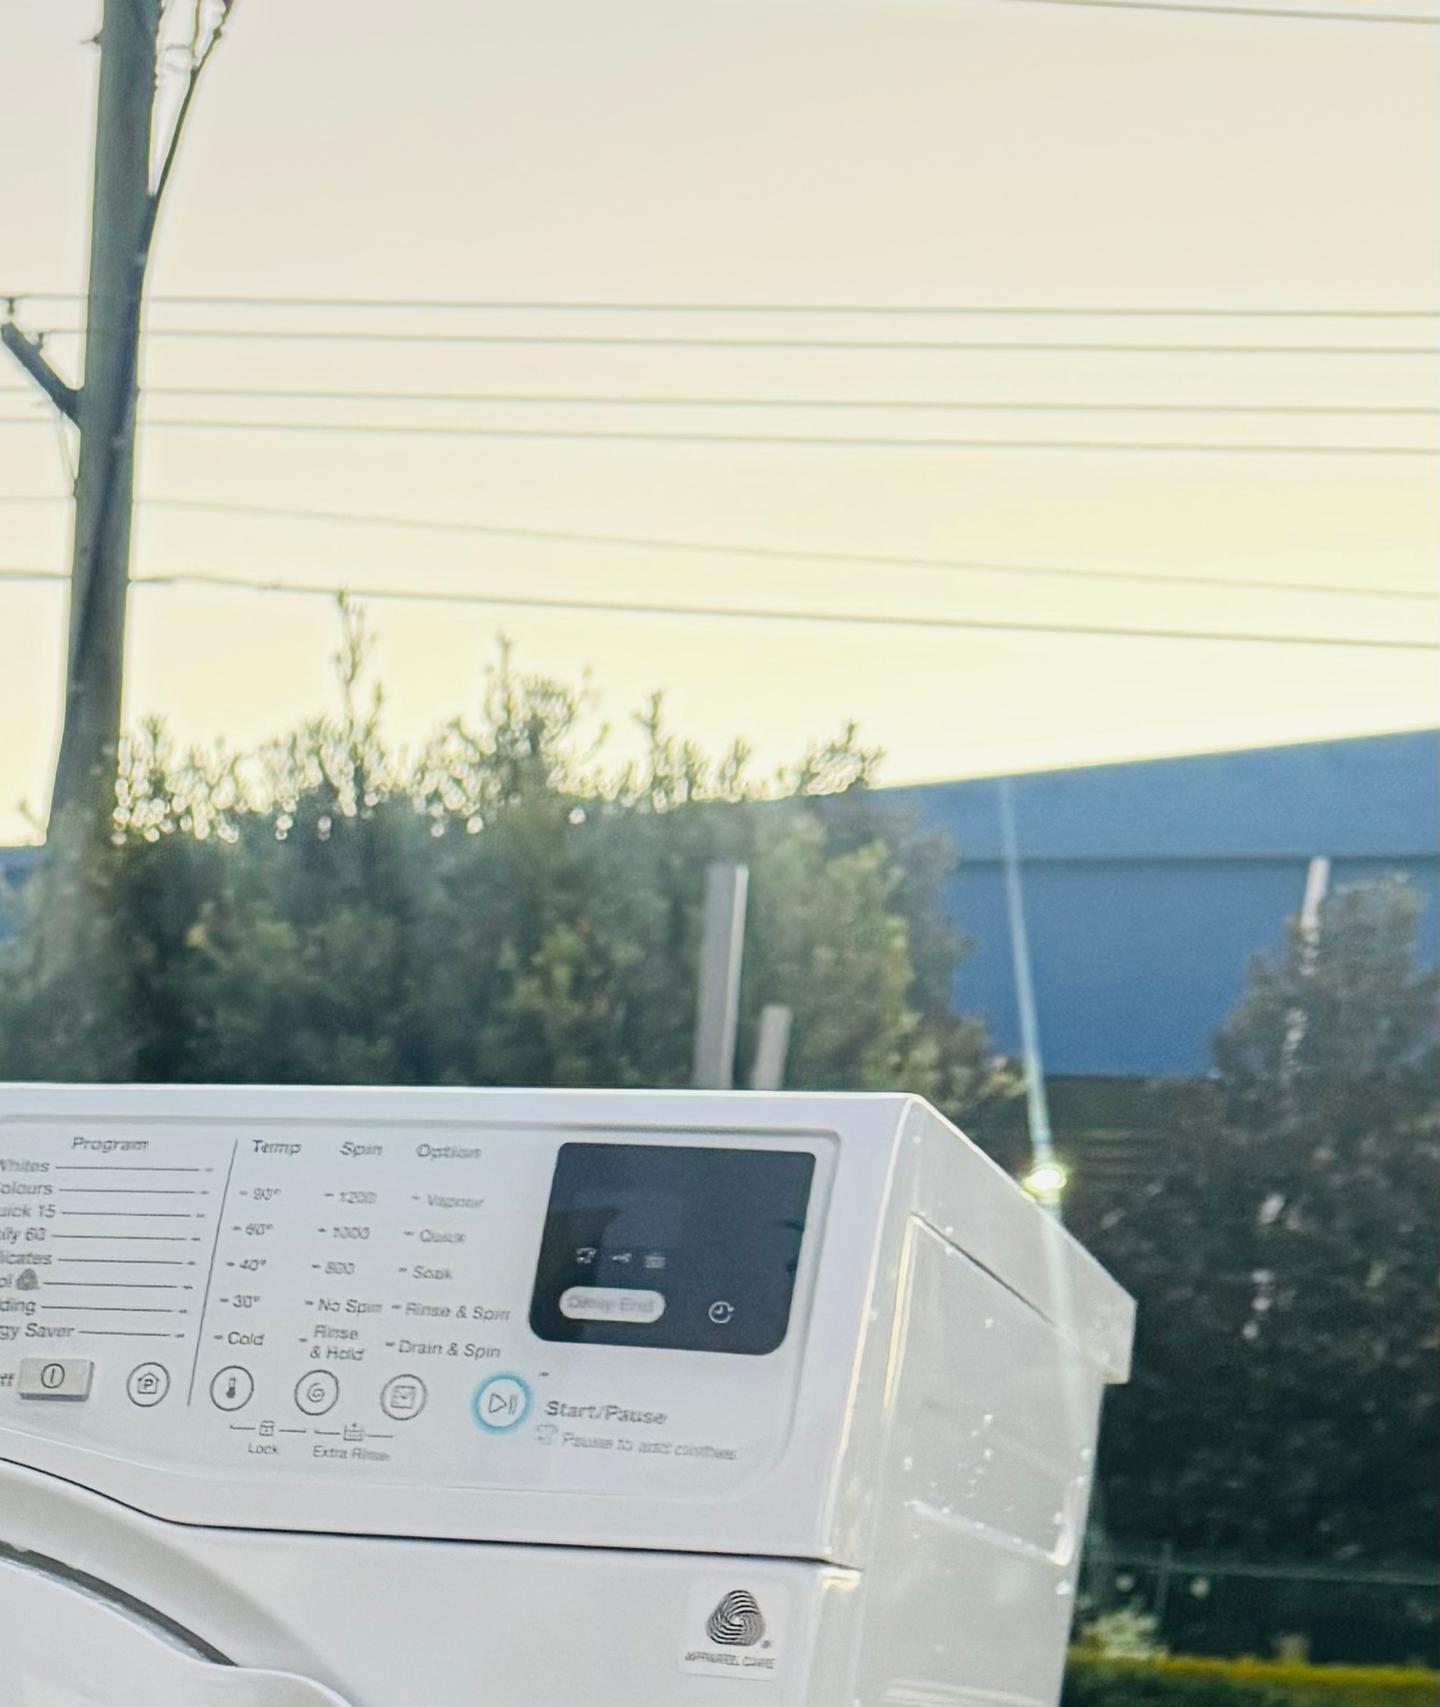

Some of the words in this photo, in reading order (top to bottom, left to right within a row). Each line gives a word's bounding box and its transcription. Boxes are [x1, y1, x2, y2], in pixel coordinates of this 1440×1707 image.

[71, 1136, 149, 1153] Program
[253, 1139, 301, 1155] Temp
[340, 1142, 383, 1157] Spin
[416, 1144, 481, 1161] Option
[38, 1204, 56, 1218] 15
[25, 1227, 46, 1241] 60
[317, 1299, 340, 1312] No
[344, 1300, 383, 1315] Spin
[406, 1303, 450, 1318] Rinse
[455, 1305, 467, 1319] &
[473, 1305, 510, 1322] Spin
[25, 1323, 75, 1338] Saver
[313, 1325, 359, 1341] Rinse
[228, 1332, 265, 1346] Cold
[310, 1347, 321, 1359] &
[326, 1347, 364, 1361] Hold
[399, 1340, 442, 1354] Drain
[447, 1343, 458, 1356] &
[463, 1344, 501, 1360] Spin
[545, 1400, 668, 1425] Start/Pause
[562, 1432, 613, 1450] Pause
[248, 1443, 279, 1456] Lock
[313, 1446, 348, 1459] Extra
[352, 1448, 391, 1461] Rinse
